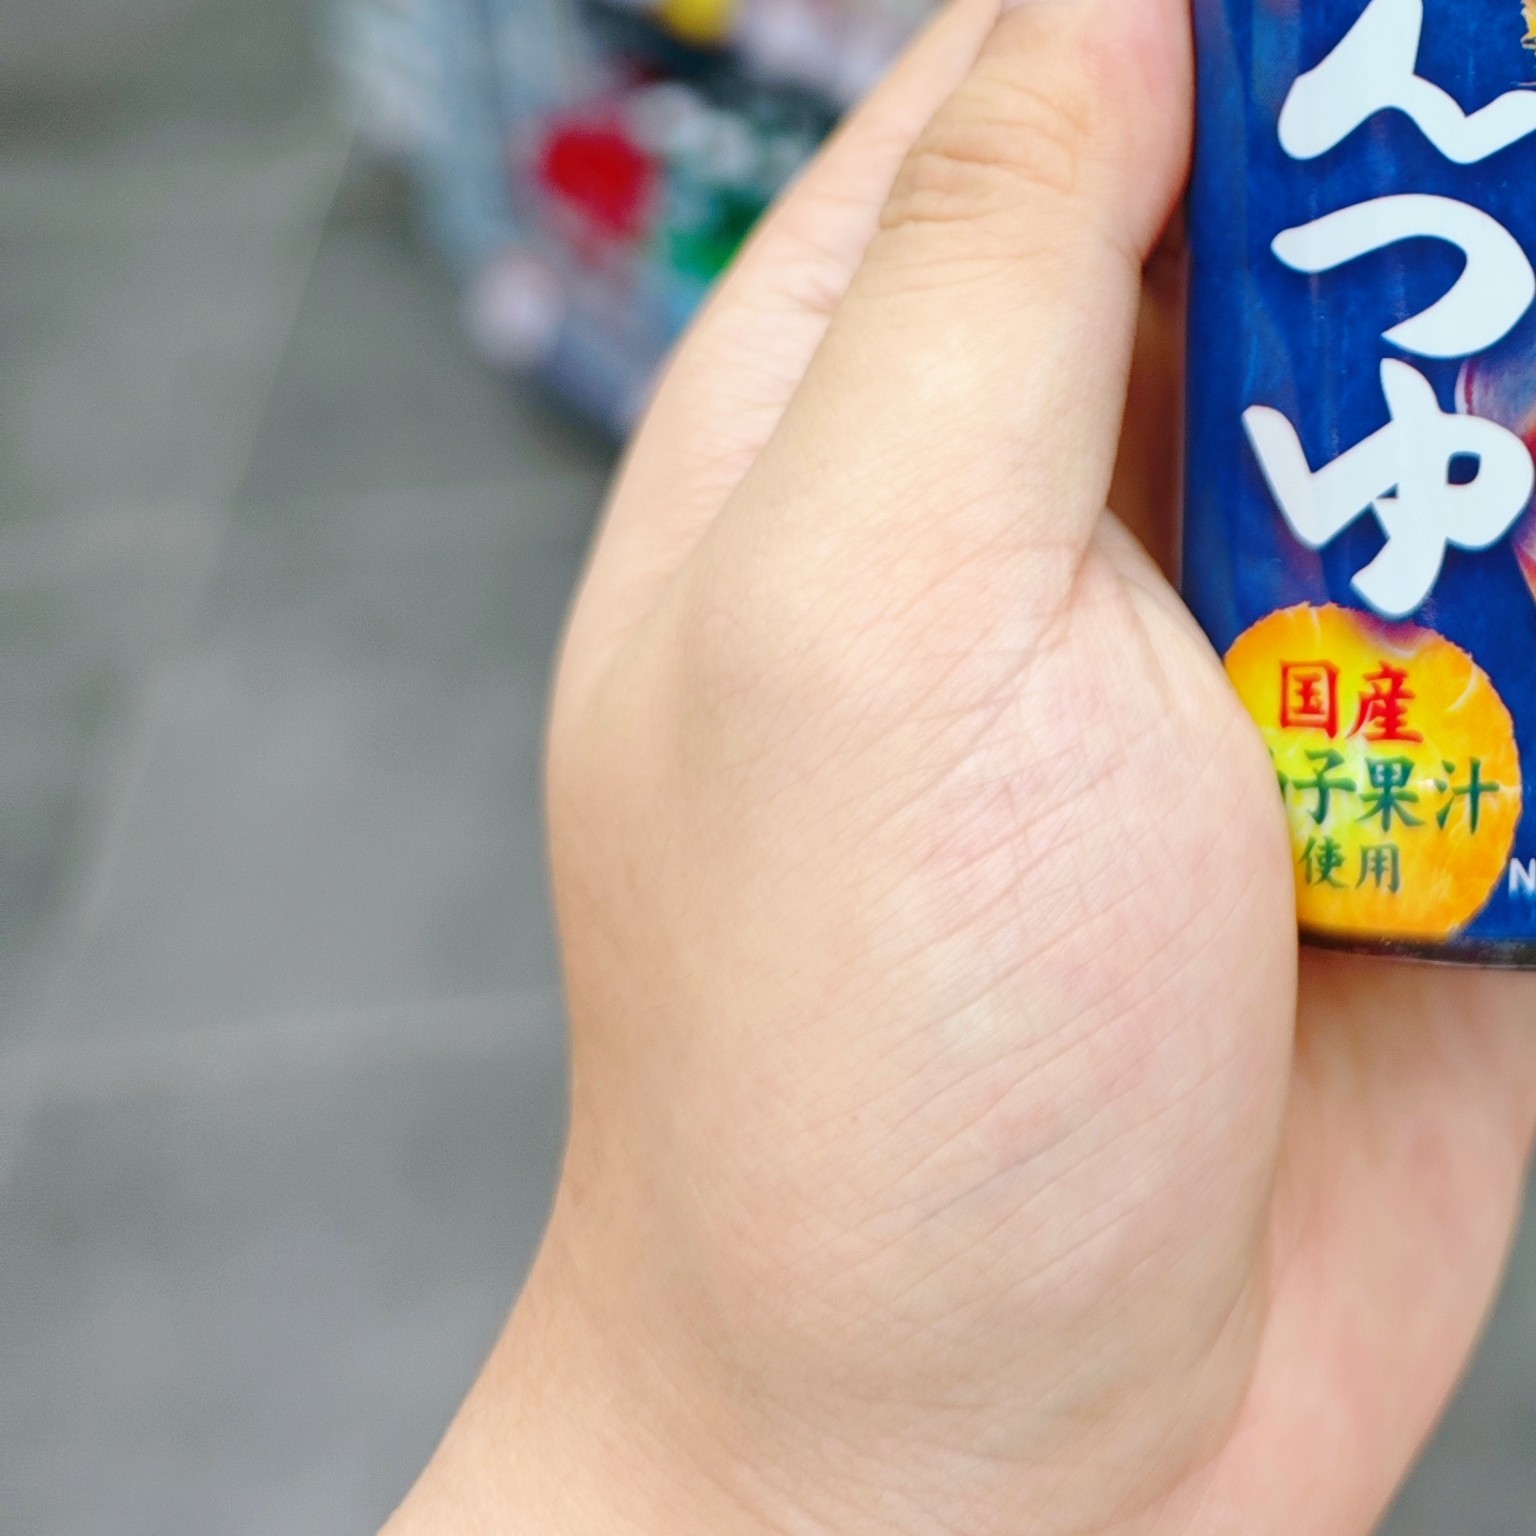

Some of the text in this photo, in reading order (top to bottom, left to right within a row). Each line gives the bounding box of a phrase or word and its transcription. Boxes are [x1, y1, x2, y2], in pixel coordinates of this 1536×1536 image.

[1278, 659, 1424, 745] 国産
[1268, 747, 1500, 835] 子果汁
[1297, 835, 1402, 894] 使用
